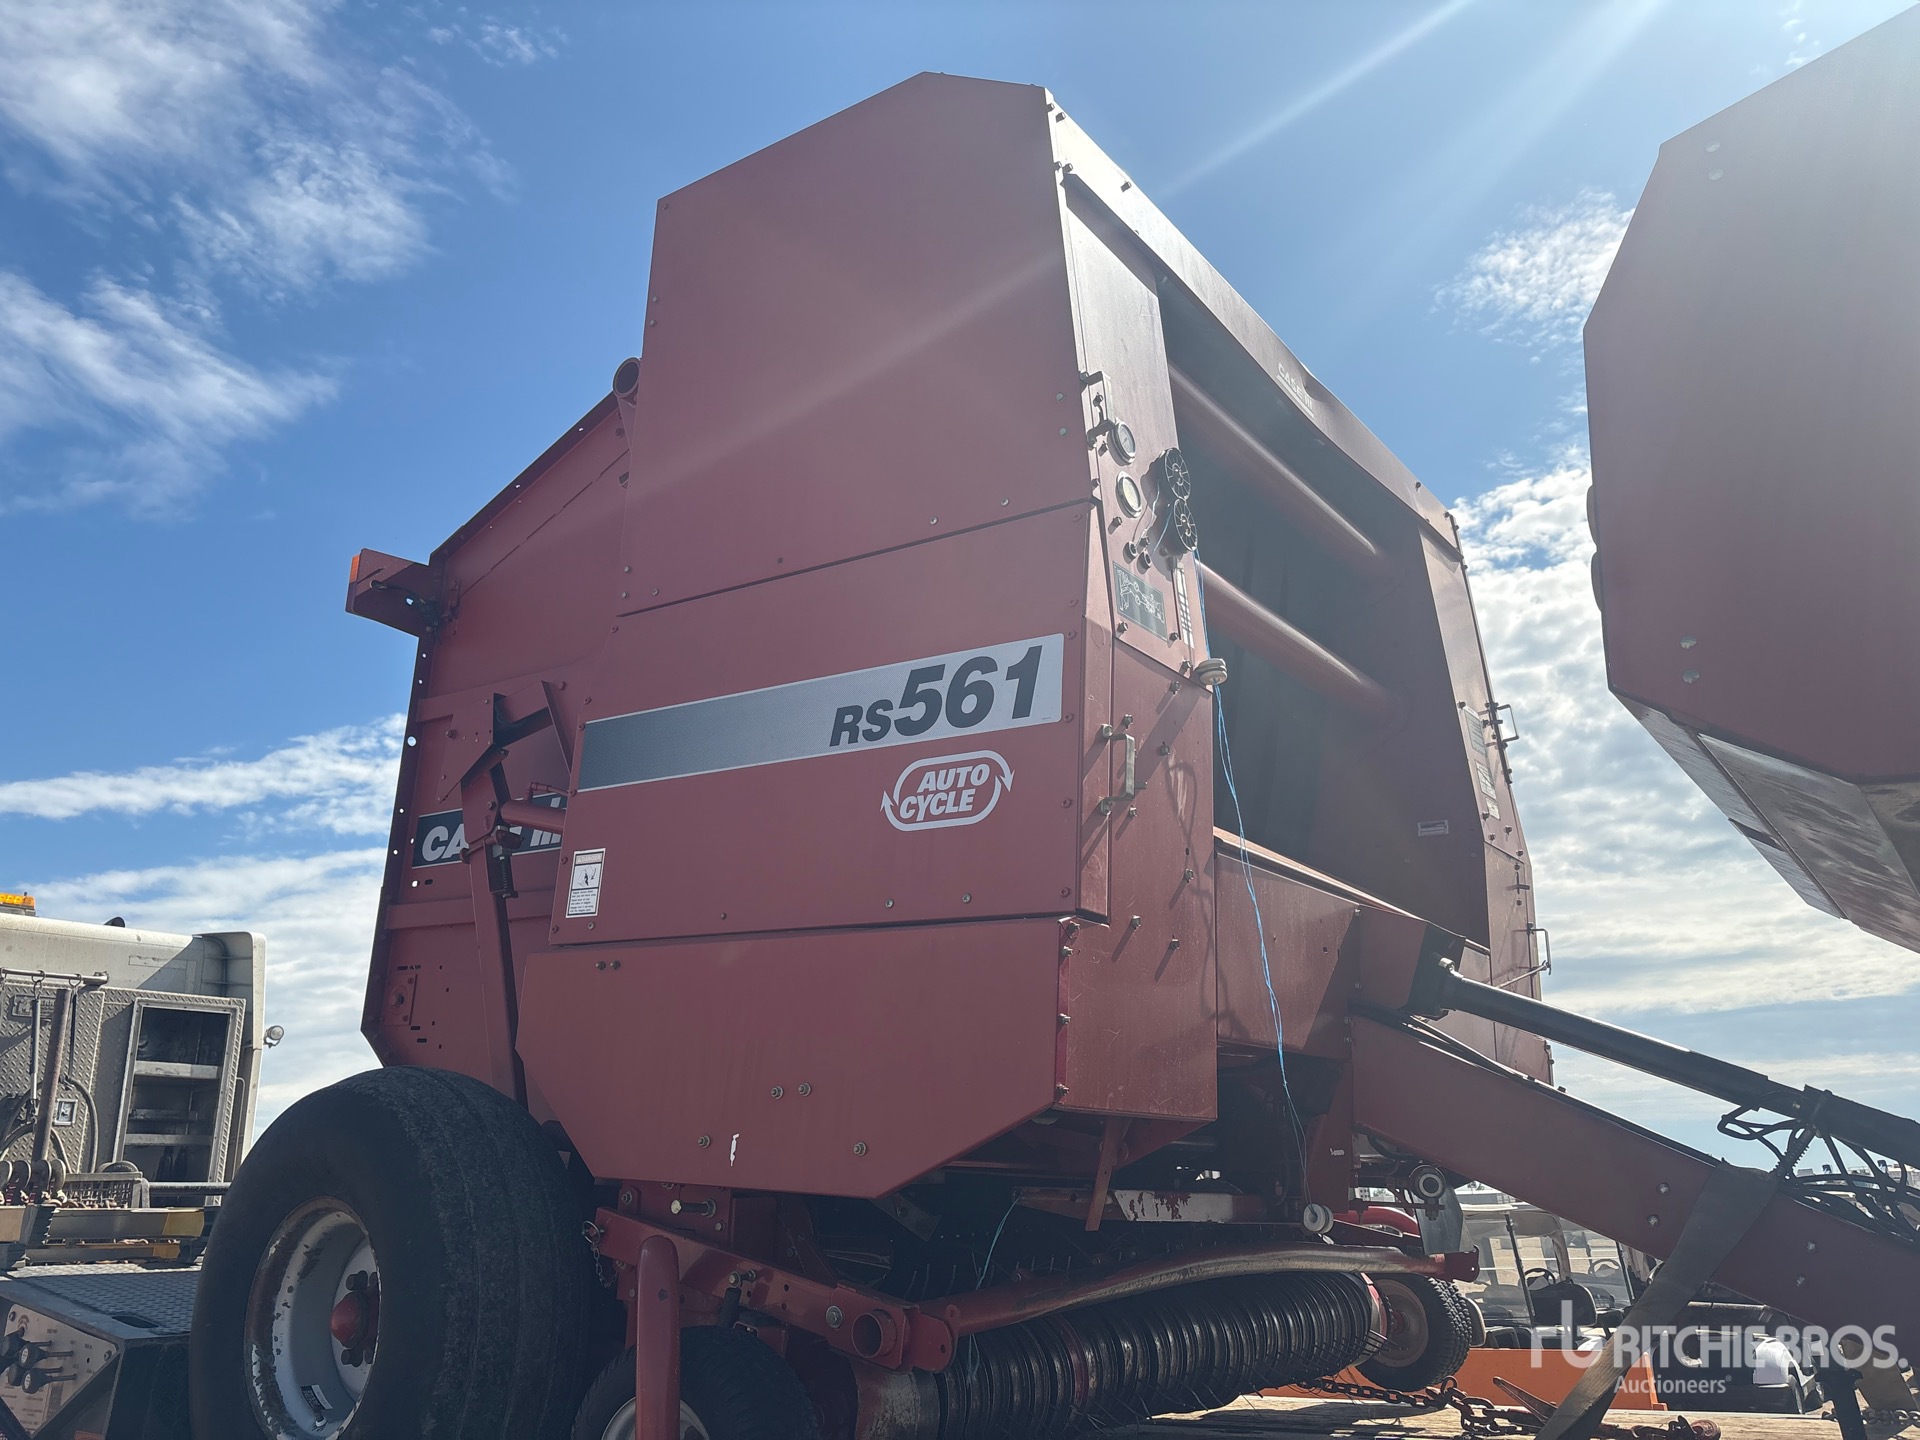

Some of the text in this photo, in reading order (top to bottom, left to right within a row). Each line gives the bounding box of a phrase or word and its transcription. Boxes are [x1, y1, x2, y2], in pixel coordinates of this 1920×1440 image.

[829, 645, 1043, 747] RS561
[917, 763, 990, 793] AUTO
[900, 788, 976, 821] CYCLE
